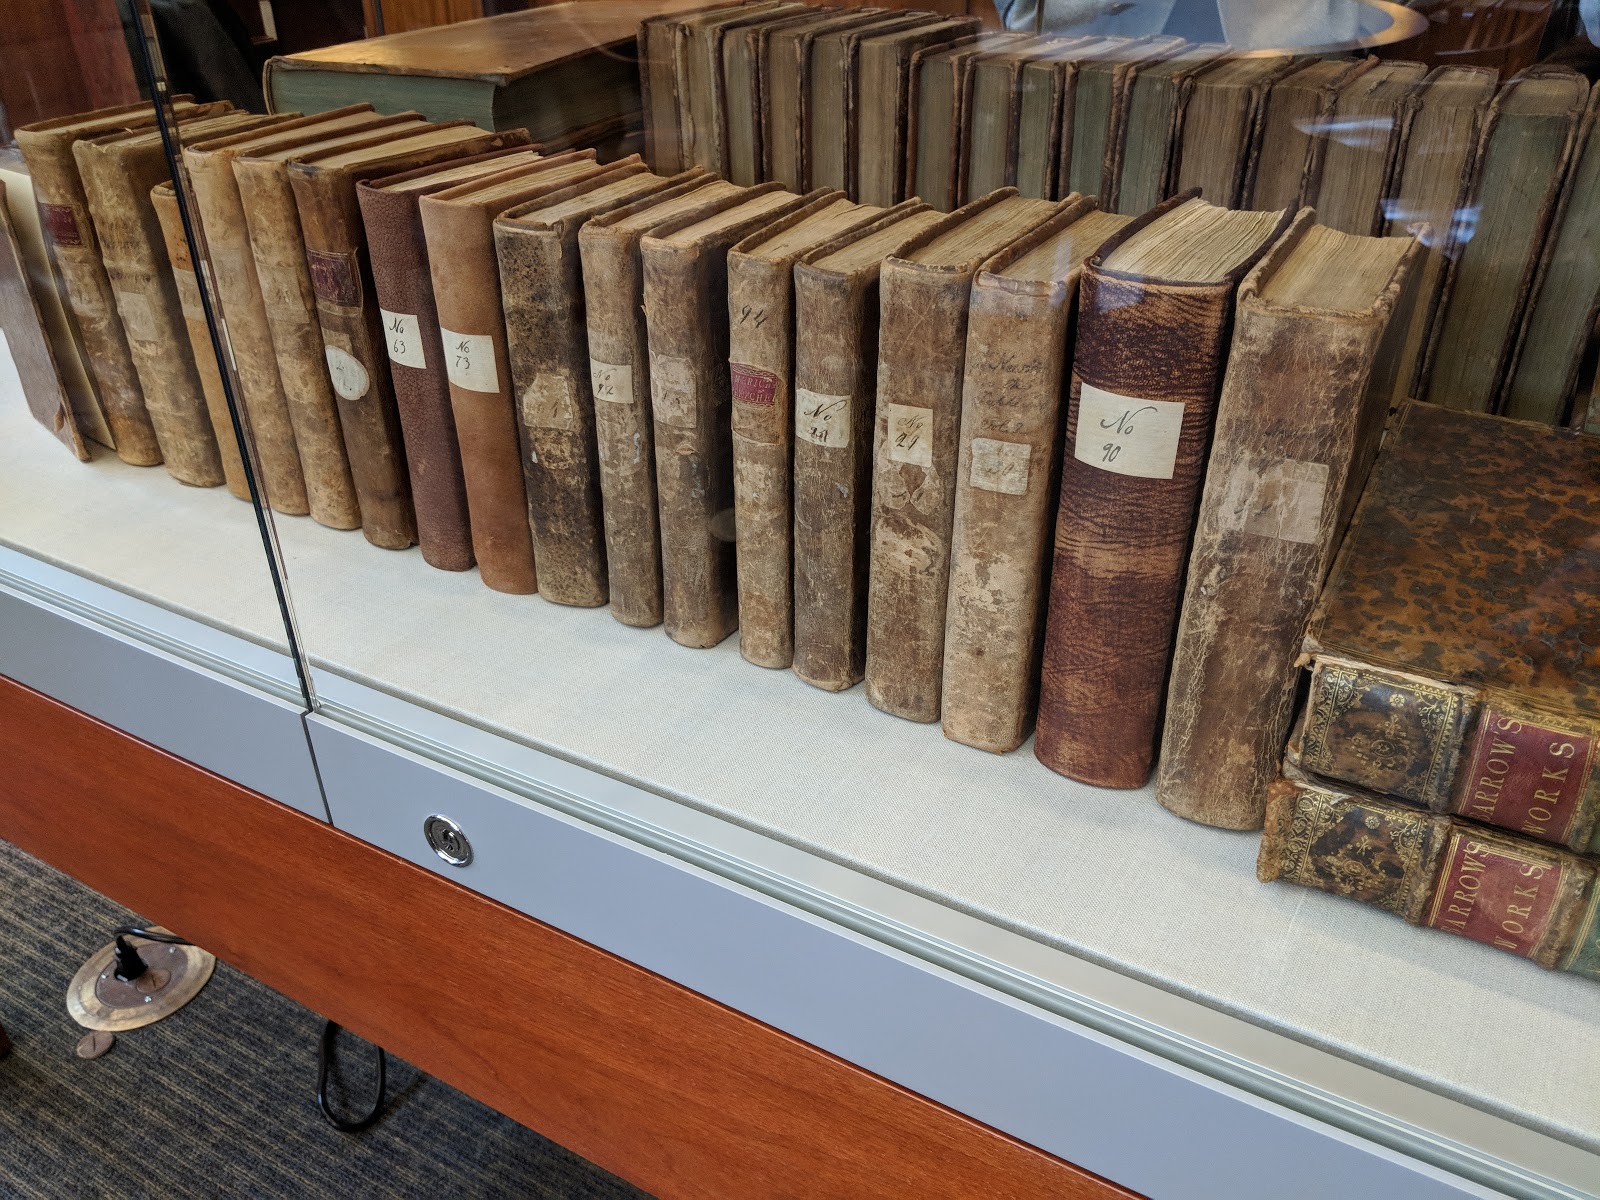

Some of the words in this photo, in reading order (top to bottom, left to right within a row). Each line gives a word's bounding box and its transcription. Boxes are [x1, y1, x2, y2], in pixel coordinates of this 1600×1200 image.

[740, 304, 768, 329] 94
[393, 339, 406, 354] 63
[455, 355, 471, 370] 73
[803, 399, 848, 422] No
[1099, 405, 1159, 435] No
[1101, 442, 1122, 463] 90
[1521, 741, 1576, 835] WORKS
[1494, 863, 1544, 950] WORKS
